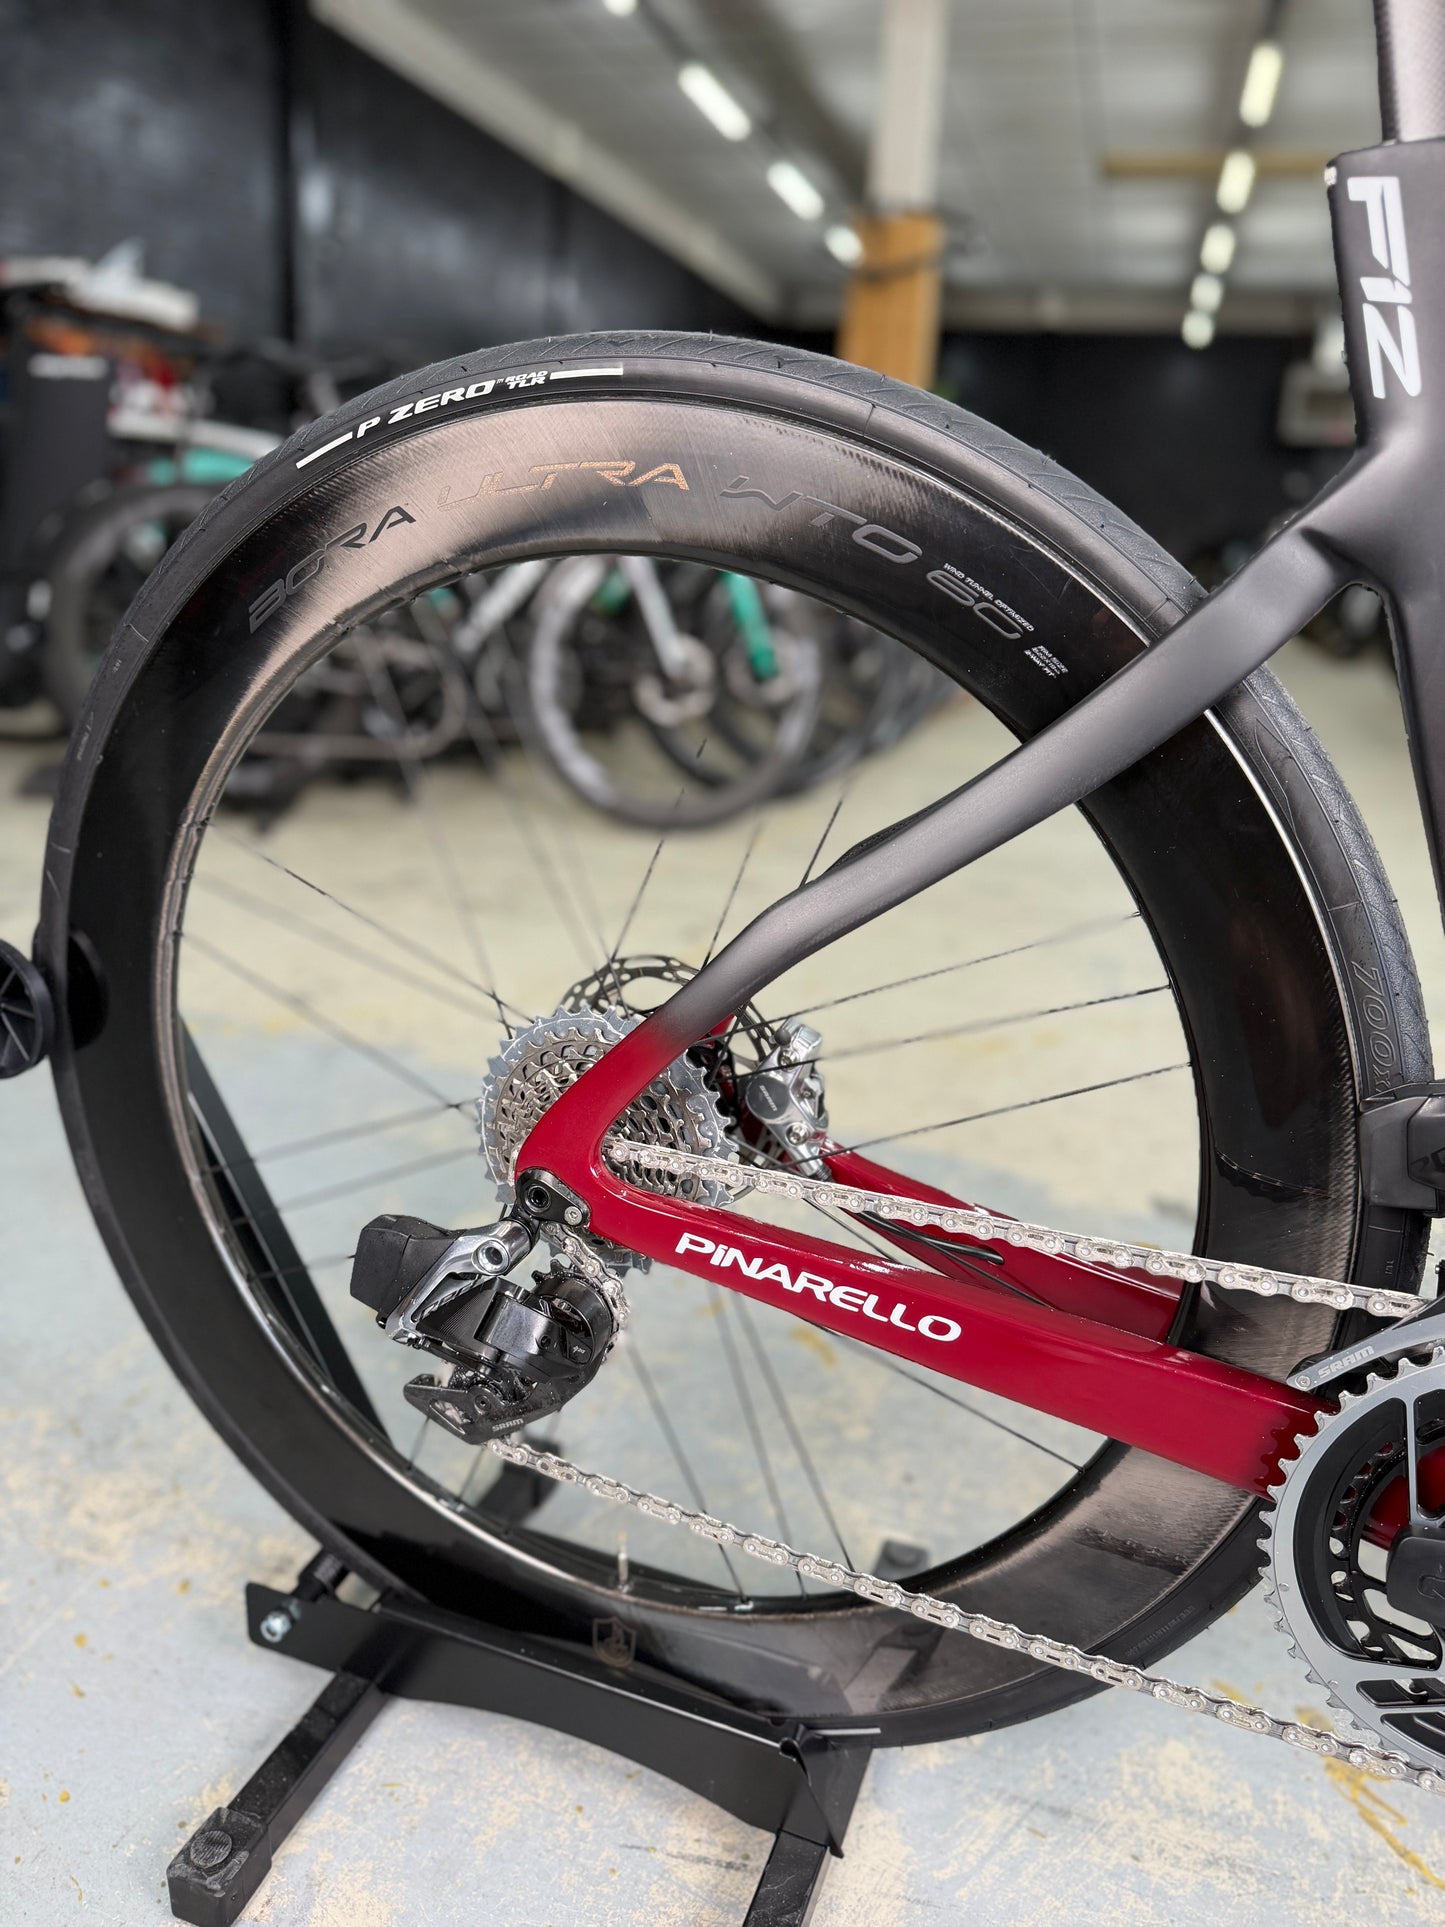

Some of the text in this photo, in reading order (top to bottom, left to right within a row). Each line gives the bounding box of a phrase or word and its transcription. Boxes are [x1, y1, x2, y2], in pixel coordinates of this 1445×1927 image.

[1347, 176, 1422, 399] F12
[505, 370, 548, 383] ROAD
[507, 377, 546, 390] TLR
[357, 416, 381, 438] P
[249, 460, 1023, 640] BORA ULTRA WTO 60
[943, 562, 965, 579] WIND
[964, 576, 994, 601] TUNNEL
[1318, 1345, 1375, 1379] SRAM
[492, 1417, 524, 1432] SRAM
